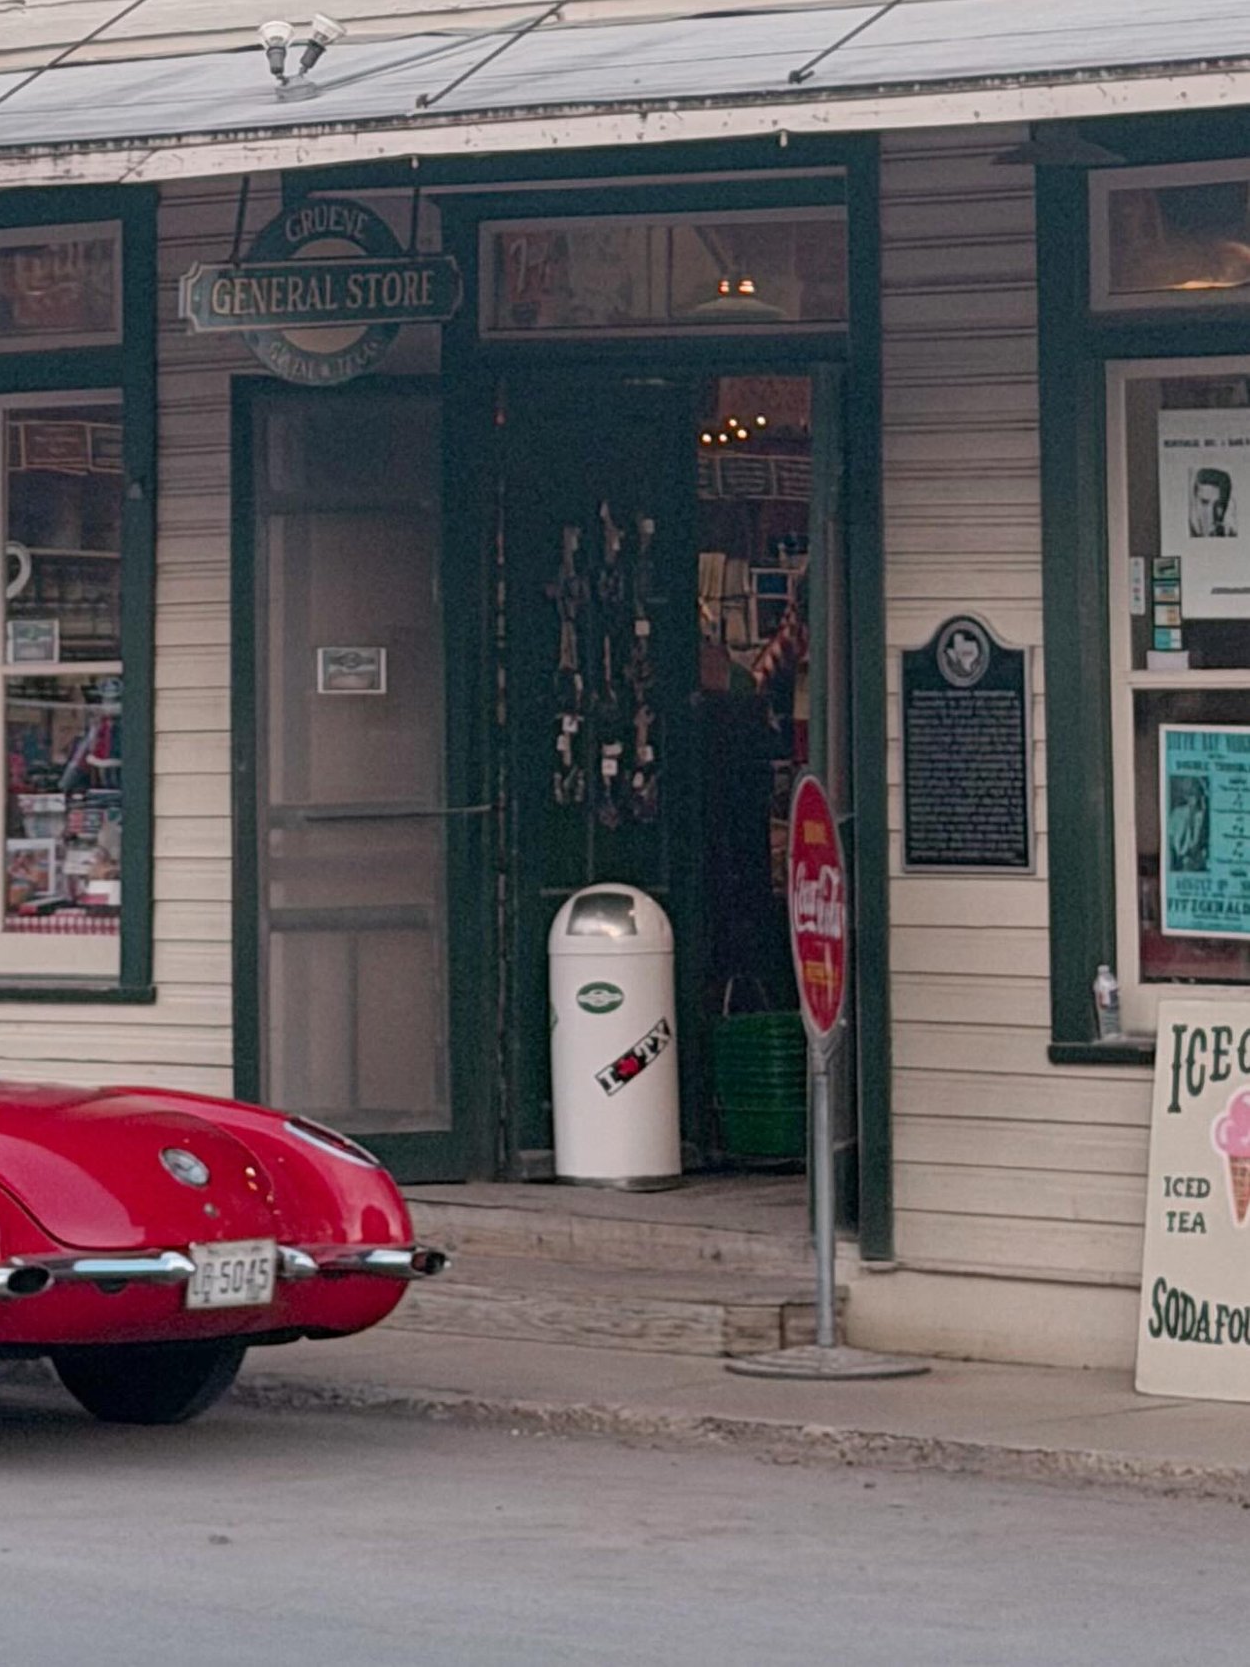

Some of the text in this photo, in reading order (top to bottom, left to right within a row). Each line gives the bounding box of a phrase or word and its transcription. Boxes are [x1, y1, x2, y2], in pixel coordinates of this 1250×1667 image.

[212, 270, 434, 315] GENERAL STORE
[1167, 1023, 1233, 1114] ICE
[1163, 1175, 1211, 1199] ICED
[1166, 1210, 1207, 1234] TEA
[1148, 1275, 1214, 1344] SODA
